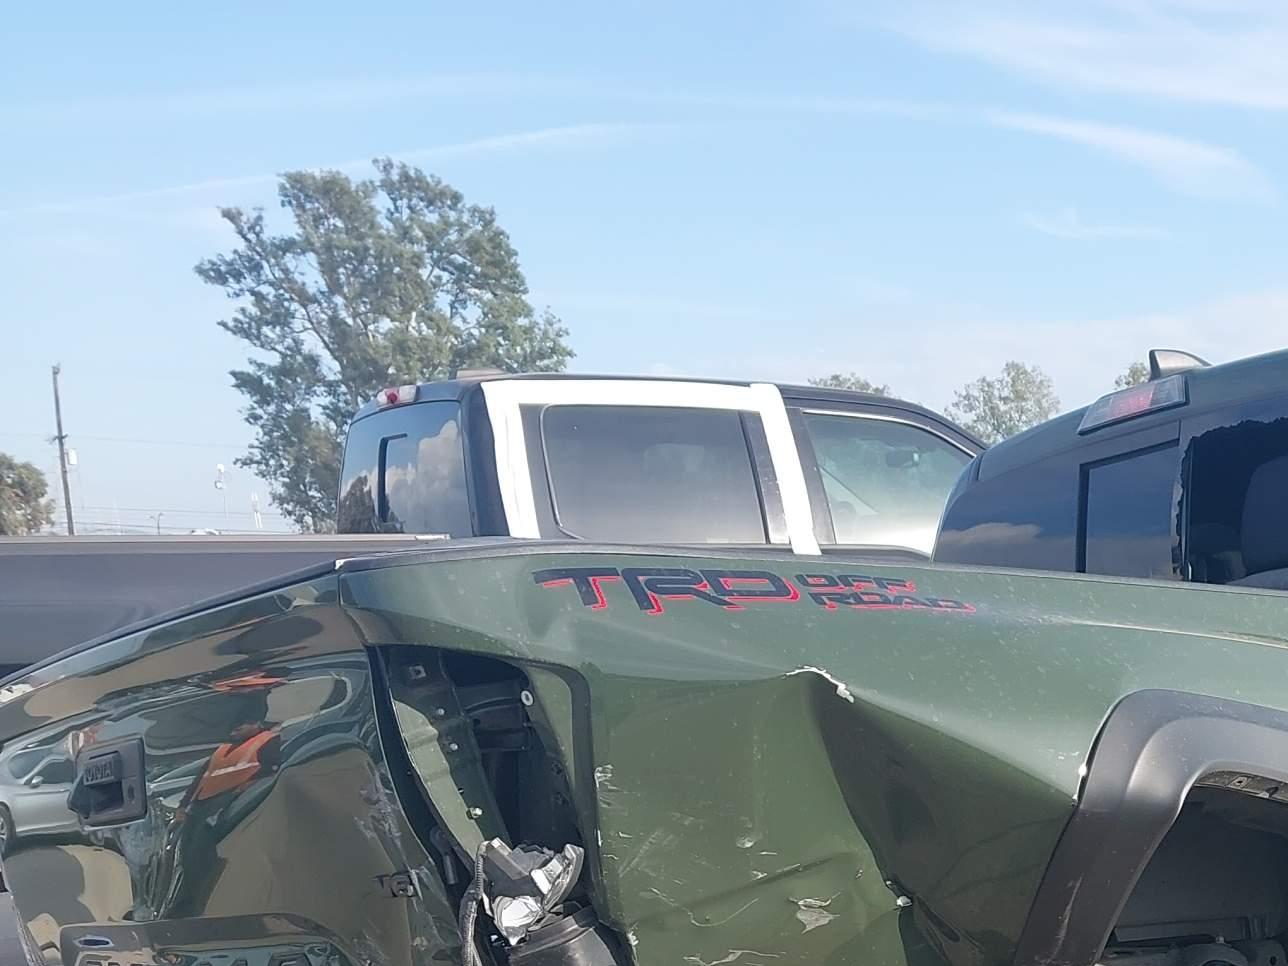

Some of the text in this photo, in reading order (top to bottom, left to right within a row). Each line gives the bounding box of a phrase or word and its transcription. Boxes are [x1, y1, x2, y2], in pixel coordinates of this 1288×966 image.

[533, 566, 800, 615] TRD
[795, 573, 916, 593] OFF
[808, 591, 977, 613] ROAD
